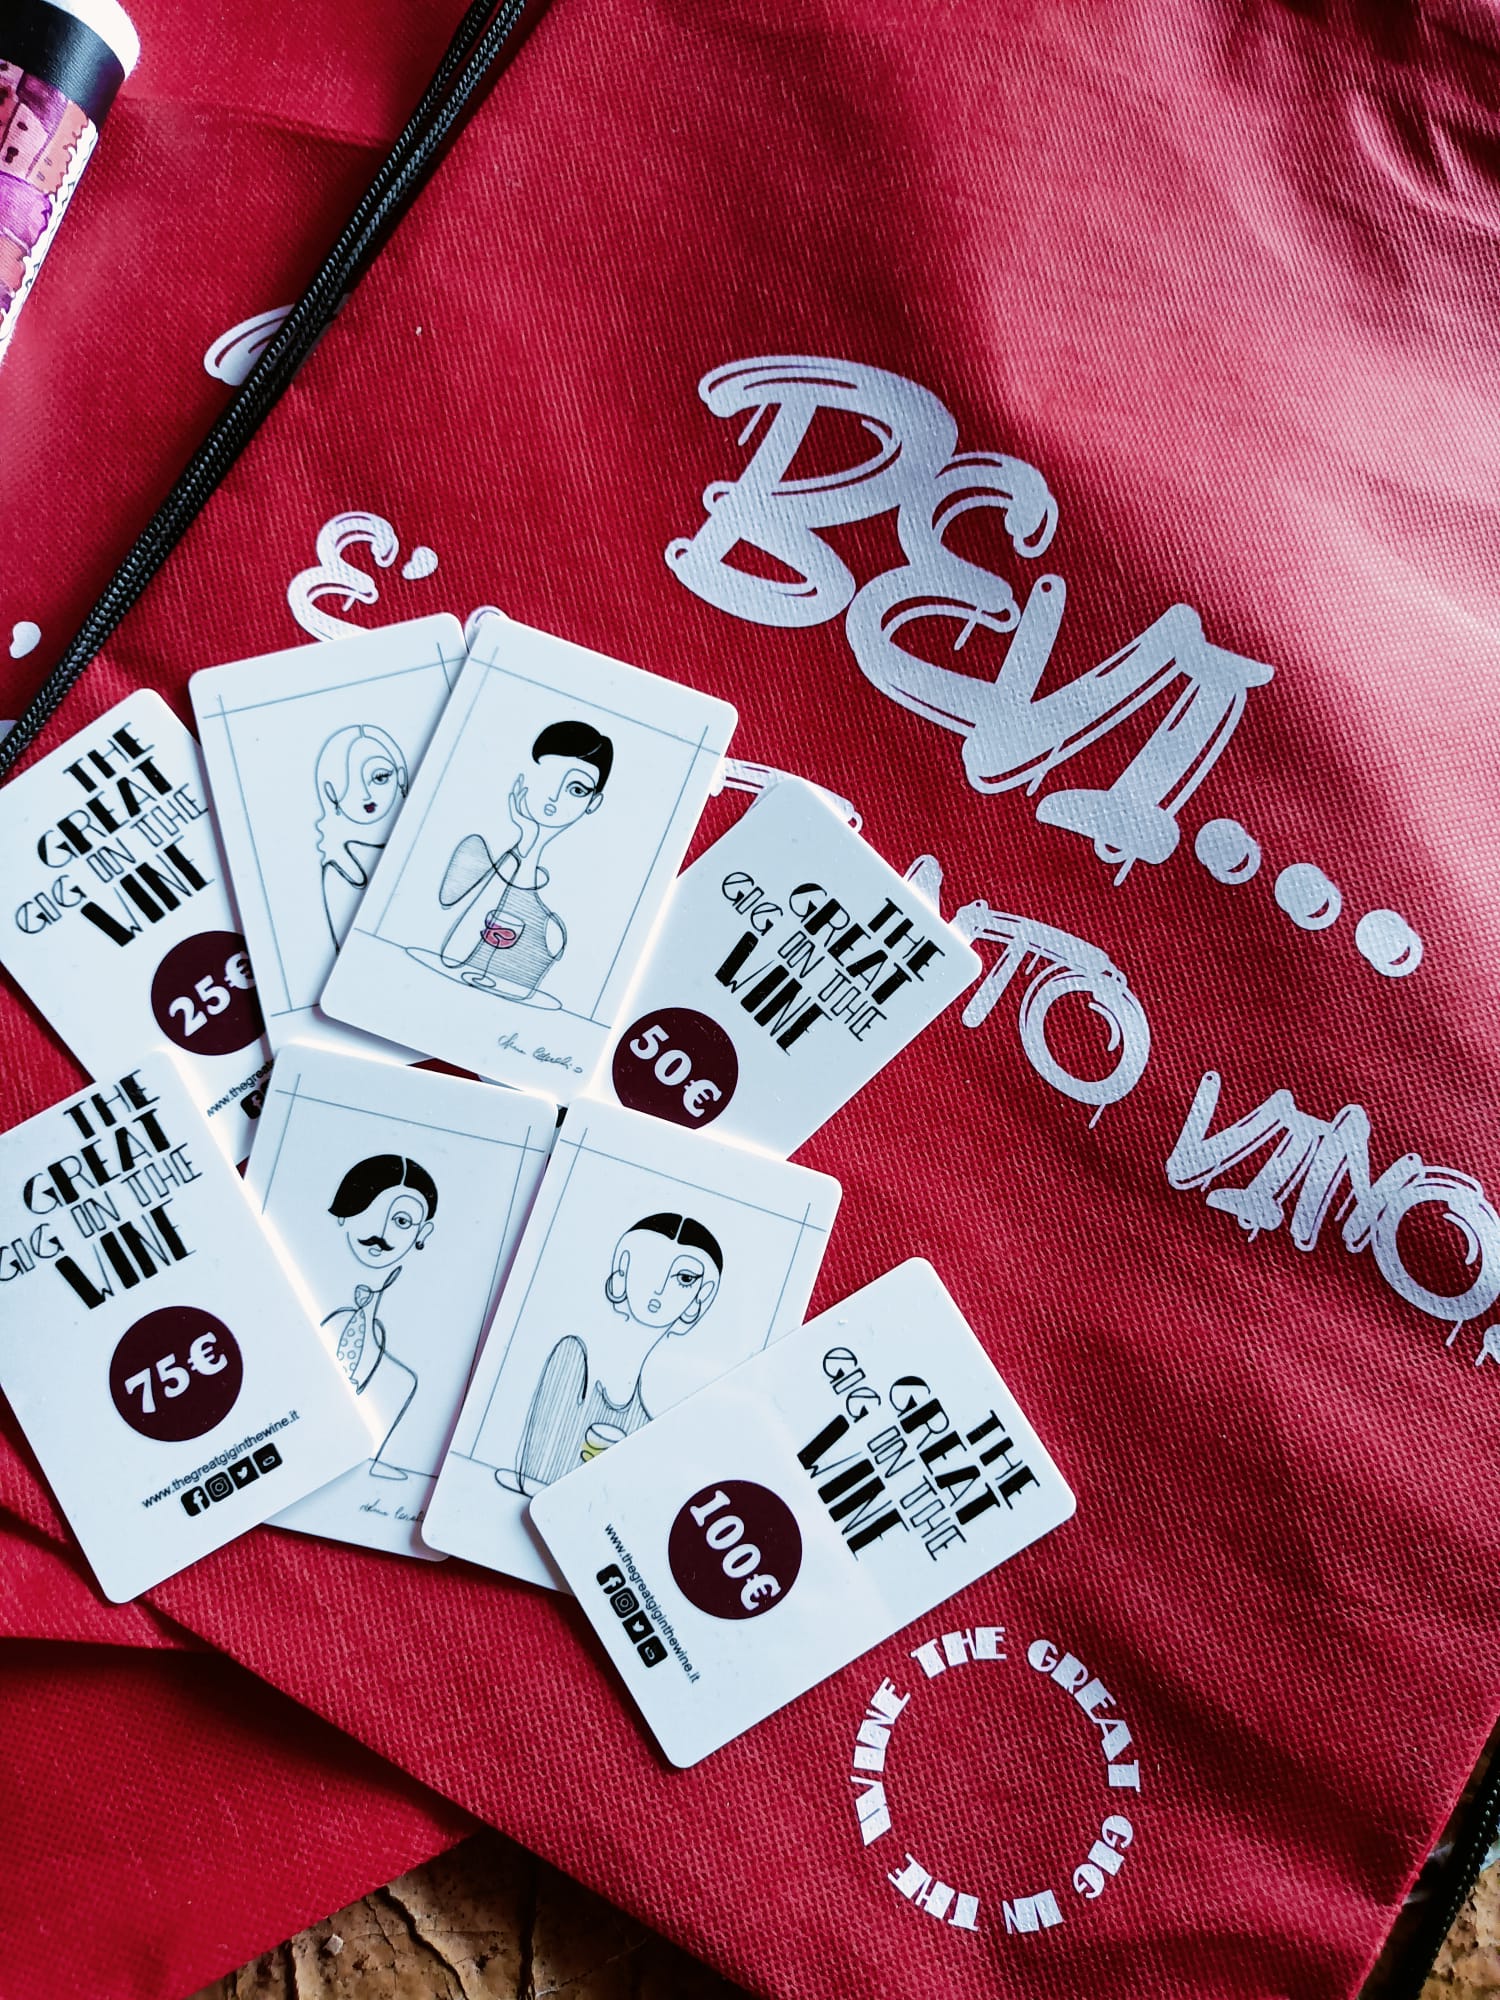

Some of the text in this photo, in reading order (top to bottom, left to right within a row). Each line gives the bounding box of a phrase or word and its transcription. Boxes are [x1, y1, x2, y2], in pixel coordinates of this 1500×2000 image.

[37, 755, 174, 869] GREAT
[62, 721, 155, 794] THE
[15, 783, 209, 934] GIG IN THE
[80, 835, 215, 948] WINE
[168, 952, 257, 1037] 25€
[714, 931, 834, 1057] WINE
[721, 871, 888, 1042] GIG IN THE
[788, 882, 914, 1006] GREAT
[867, 897, 946, 982] THE
[63, 1069, 161, 1140] THE
[629, 1024, 723, 1118] 50€
[0, 1142, 203, 1282] GIG IN THE
[23, 1107, 171, 1215] GREAT
[55, 1198, 197, 1310] WINE
[124, 1331, 229, 1414] 75€
[141, 1409, 301, 1509] www.thegreatgiginthewine.it
[796, 1414, 910, 1562] WINE
[822, 1346, 967, 1562] GIG IN THE
[889, 1375, 1001, 1526] GREAT
[965, 1409, 1041, 1511] THE
[603, 1523, 701, 1684] www.thegreatgiginthewine.it
[689, 1489, 782, 1611] 100€
[850, 1626, 1142, 1935] THE GREAT GIG IN THE WINE
